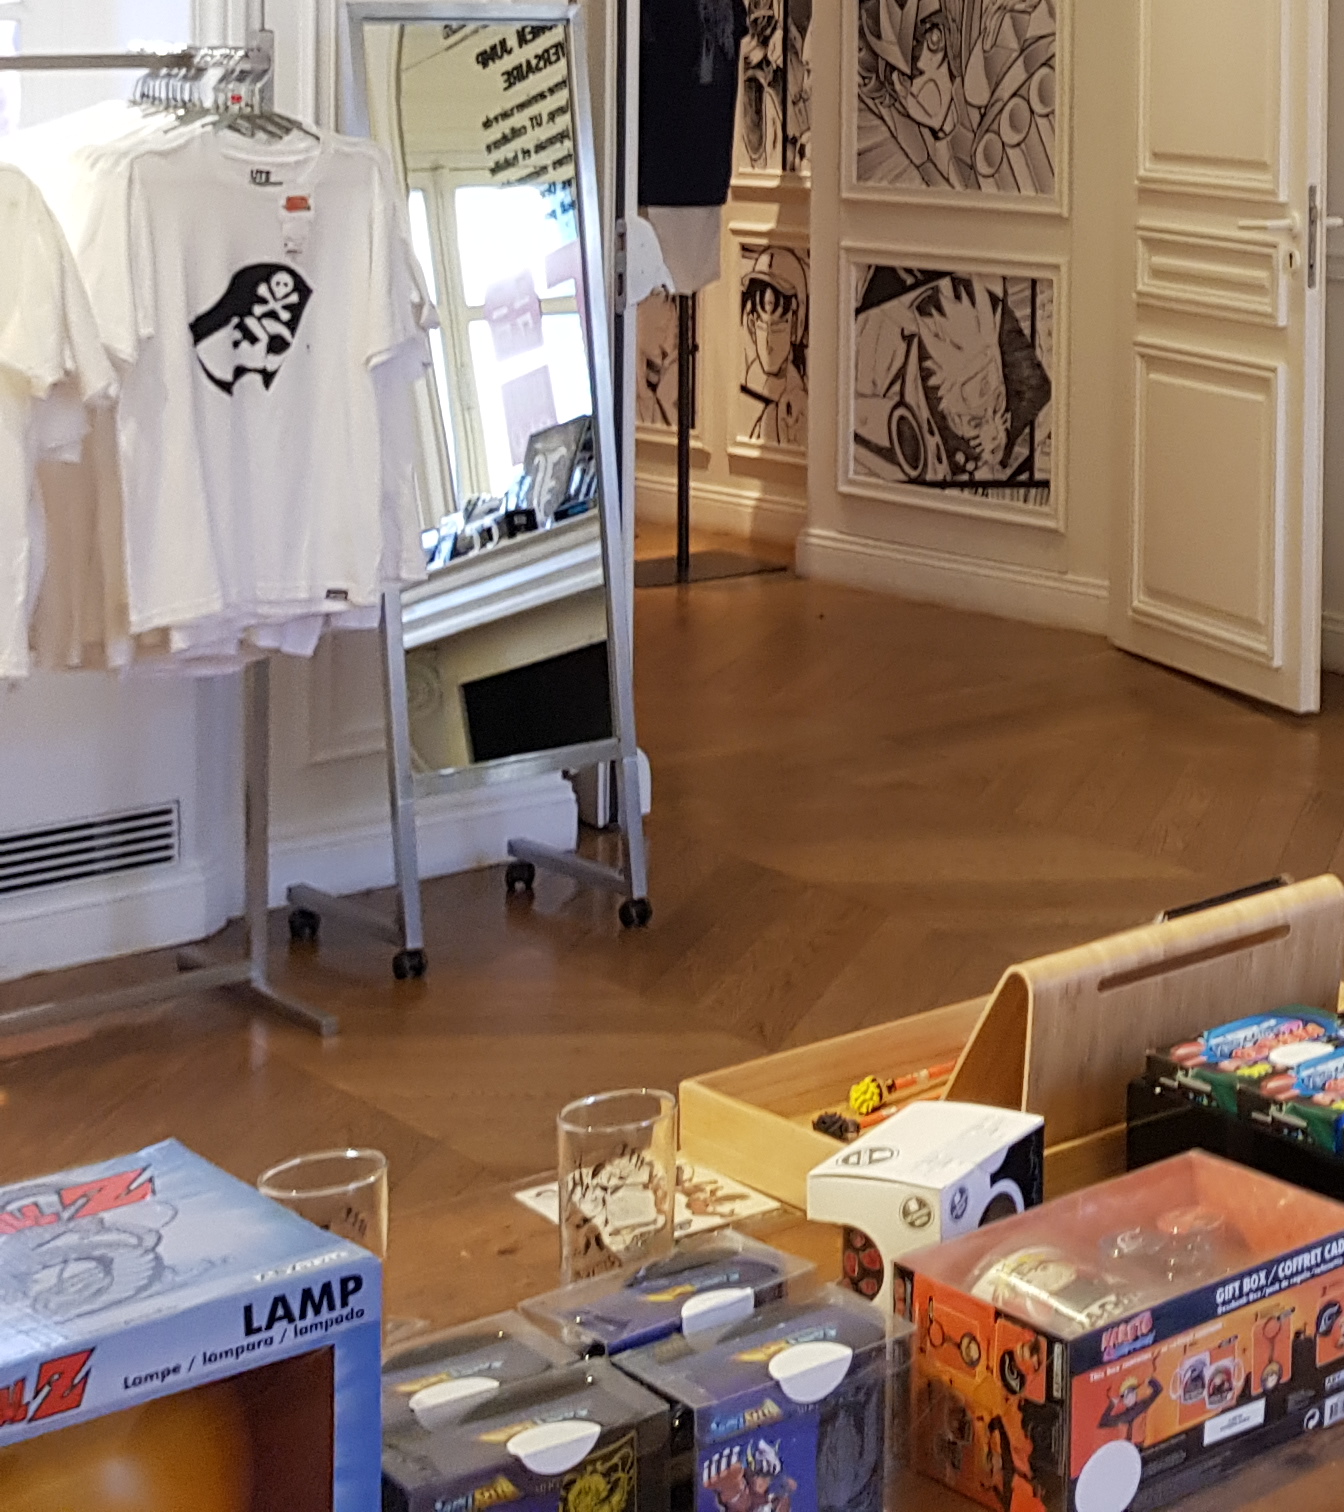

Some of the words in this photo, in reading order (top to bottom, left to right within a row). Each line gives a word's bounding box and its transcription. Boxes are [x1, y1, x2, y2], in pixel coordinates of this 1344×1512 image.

[1215, 1282, 1241, 1305] GIFT
[1243, 1268, 1267, 1294] BOX
[1278, 1246, 1322, 1280] COFFRET
[243, 1273, 364, 1338] LAMP
[123, 1364, 182, 1390] Lampe
